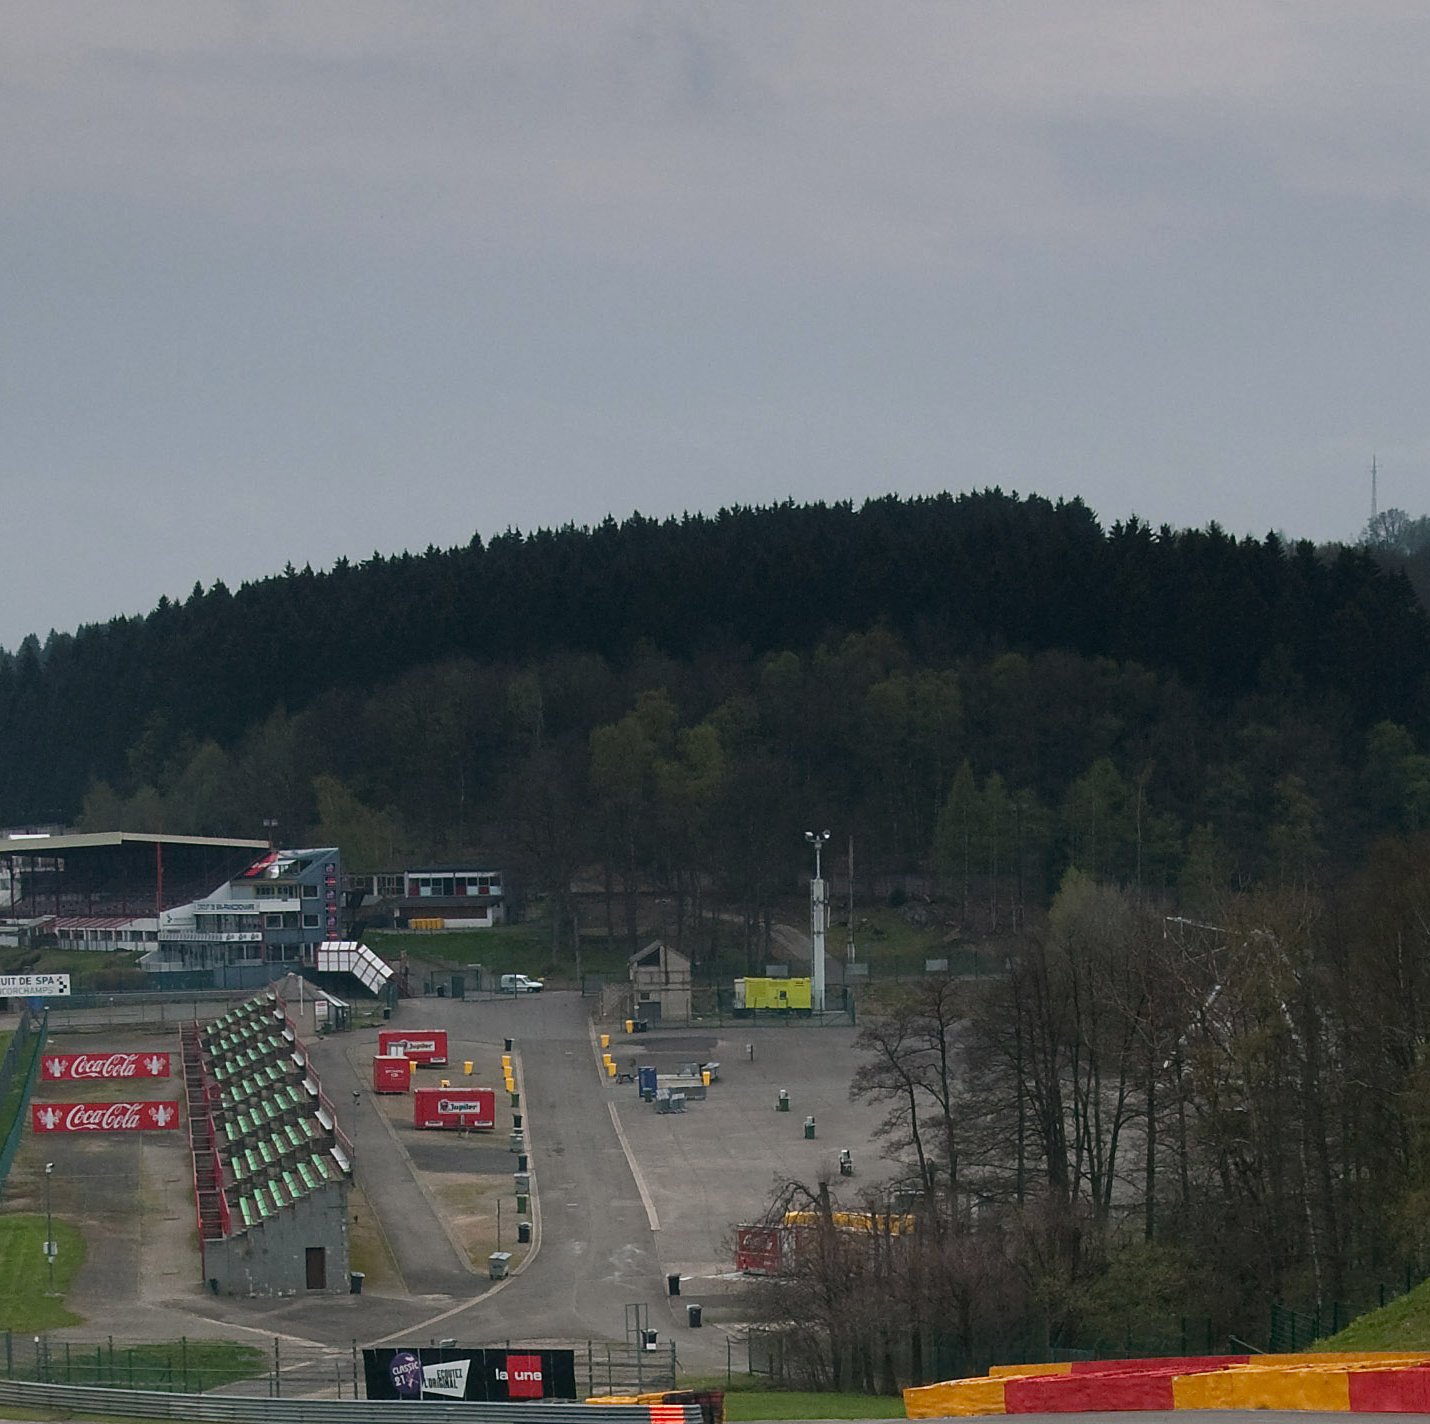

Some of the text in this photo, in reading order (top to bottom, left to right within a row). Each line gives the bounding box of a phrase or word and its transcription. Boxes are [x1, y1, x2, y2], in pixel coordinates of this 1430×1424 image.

[19, 977, 32, 985] DE
[36, 976, 55, 985] SPA
[392, 1360, 419, 1375] CLASSIC
[495, 1368, 543, 1381] la une
[394, 1375, 406, 1387] 21
